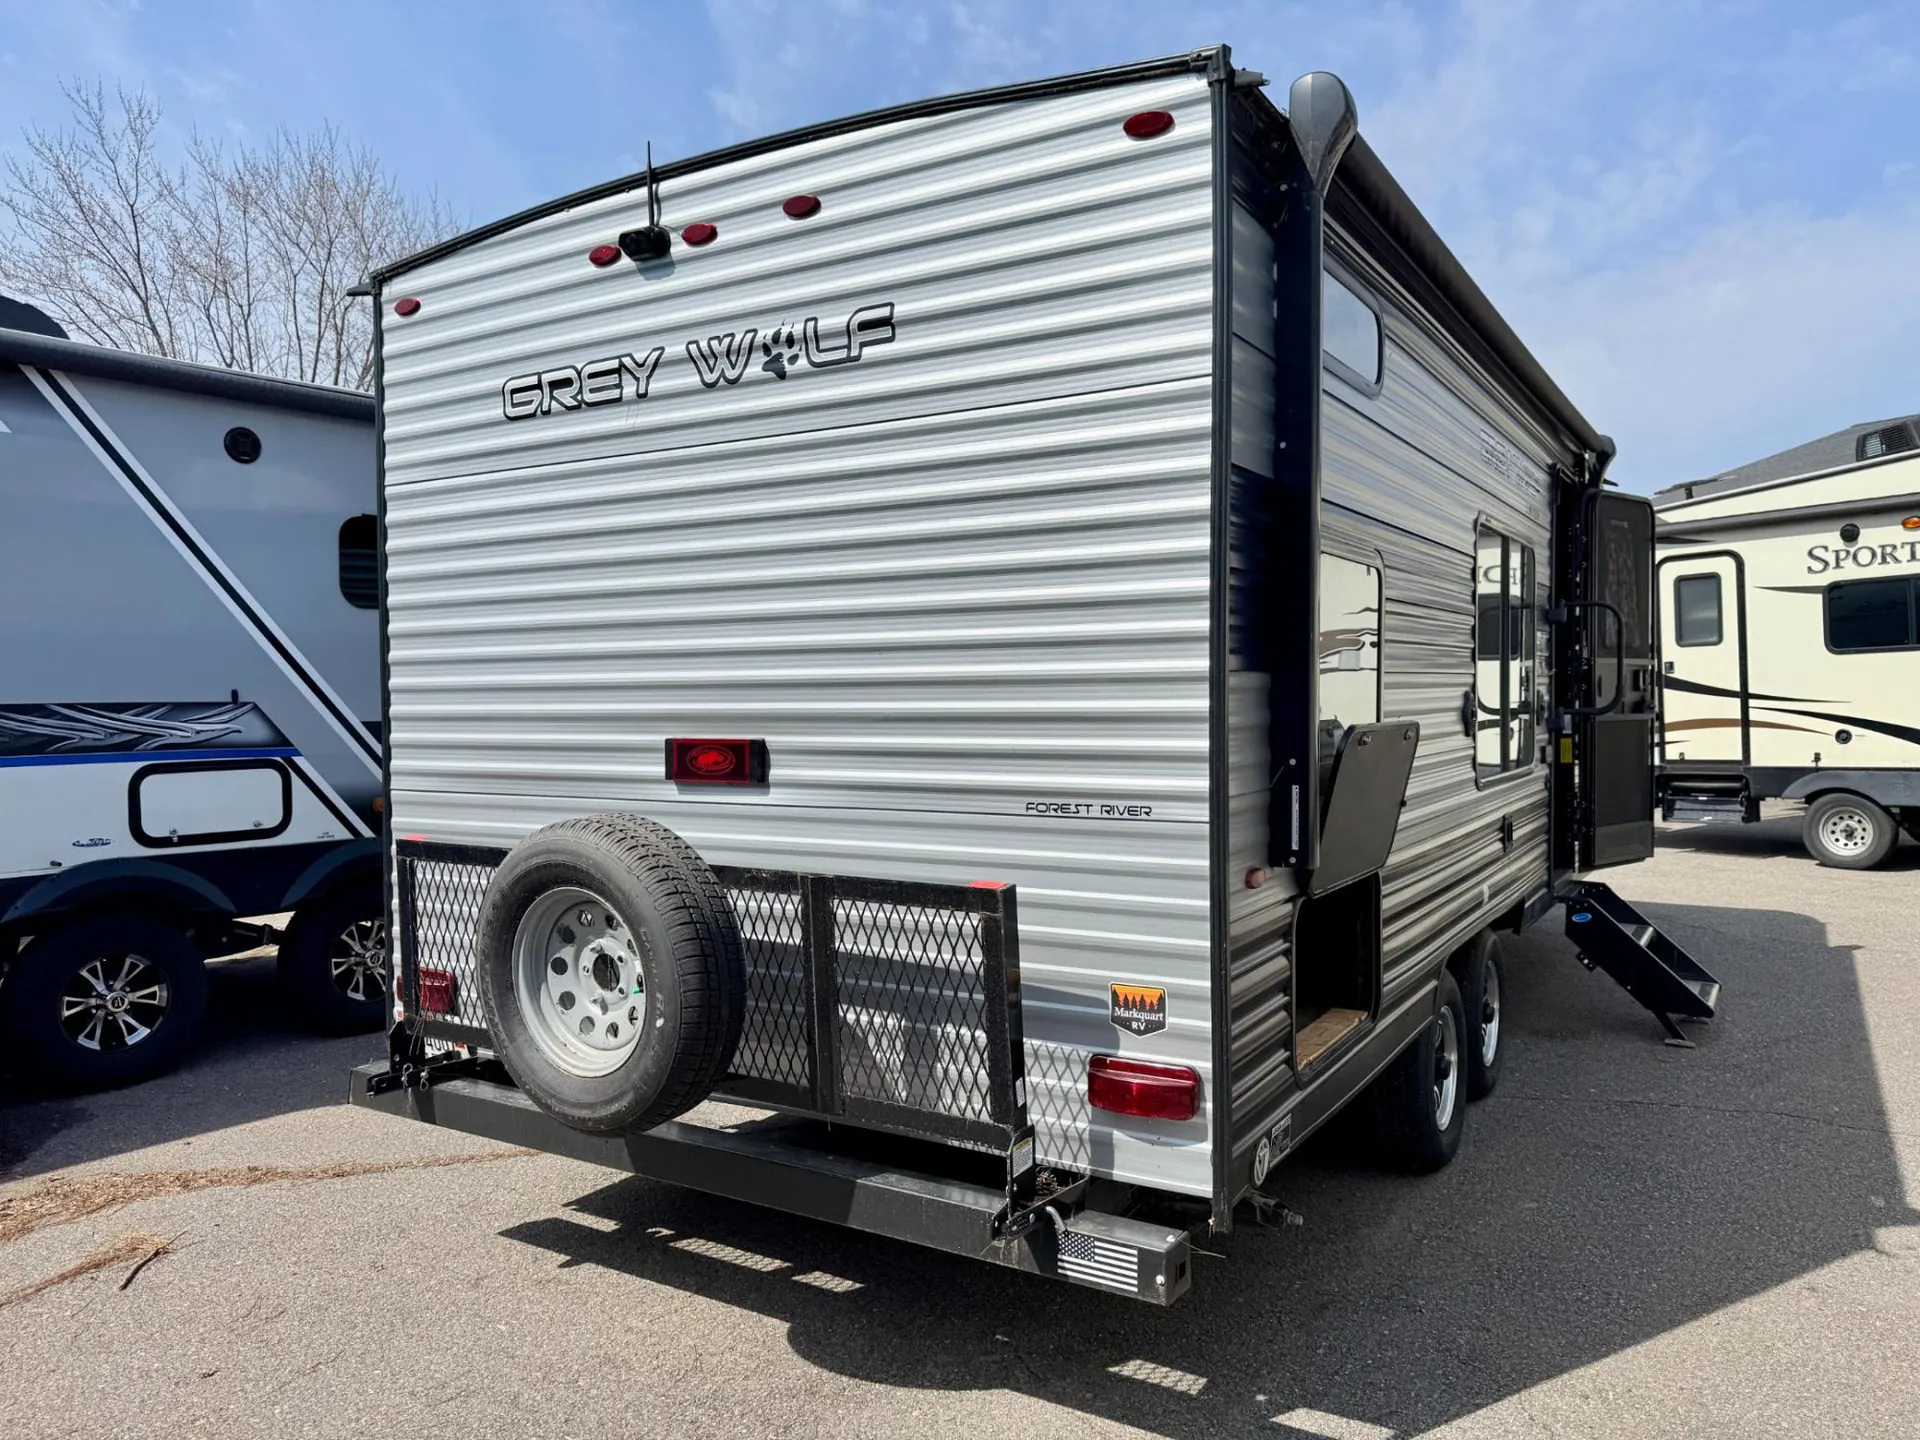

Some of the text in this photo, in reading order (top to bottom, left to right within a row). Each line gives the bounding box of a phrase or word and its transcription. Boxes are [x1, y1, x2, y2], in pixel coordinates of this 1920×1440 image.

[502, 302, 896, 421] GREY WLF
[1025, 802, 1153, 817] FOREST RIVER
[1114, 1006, 1164, 1022] Markquart
[1131, 1021, 1146, 1031] RV
